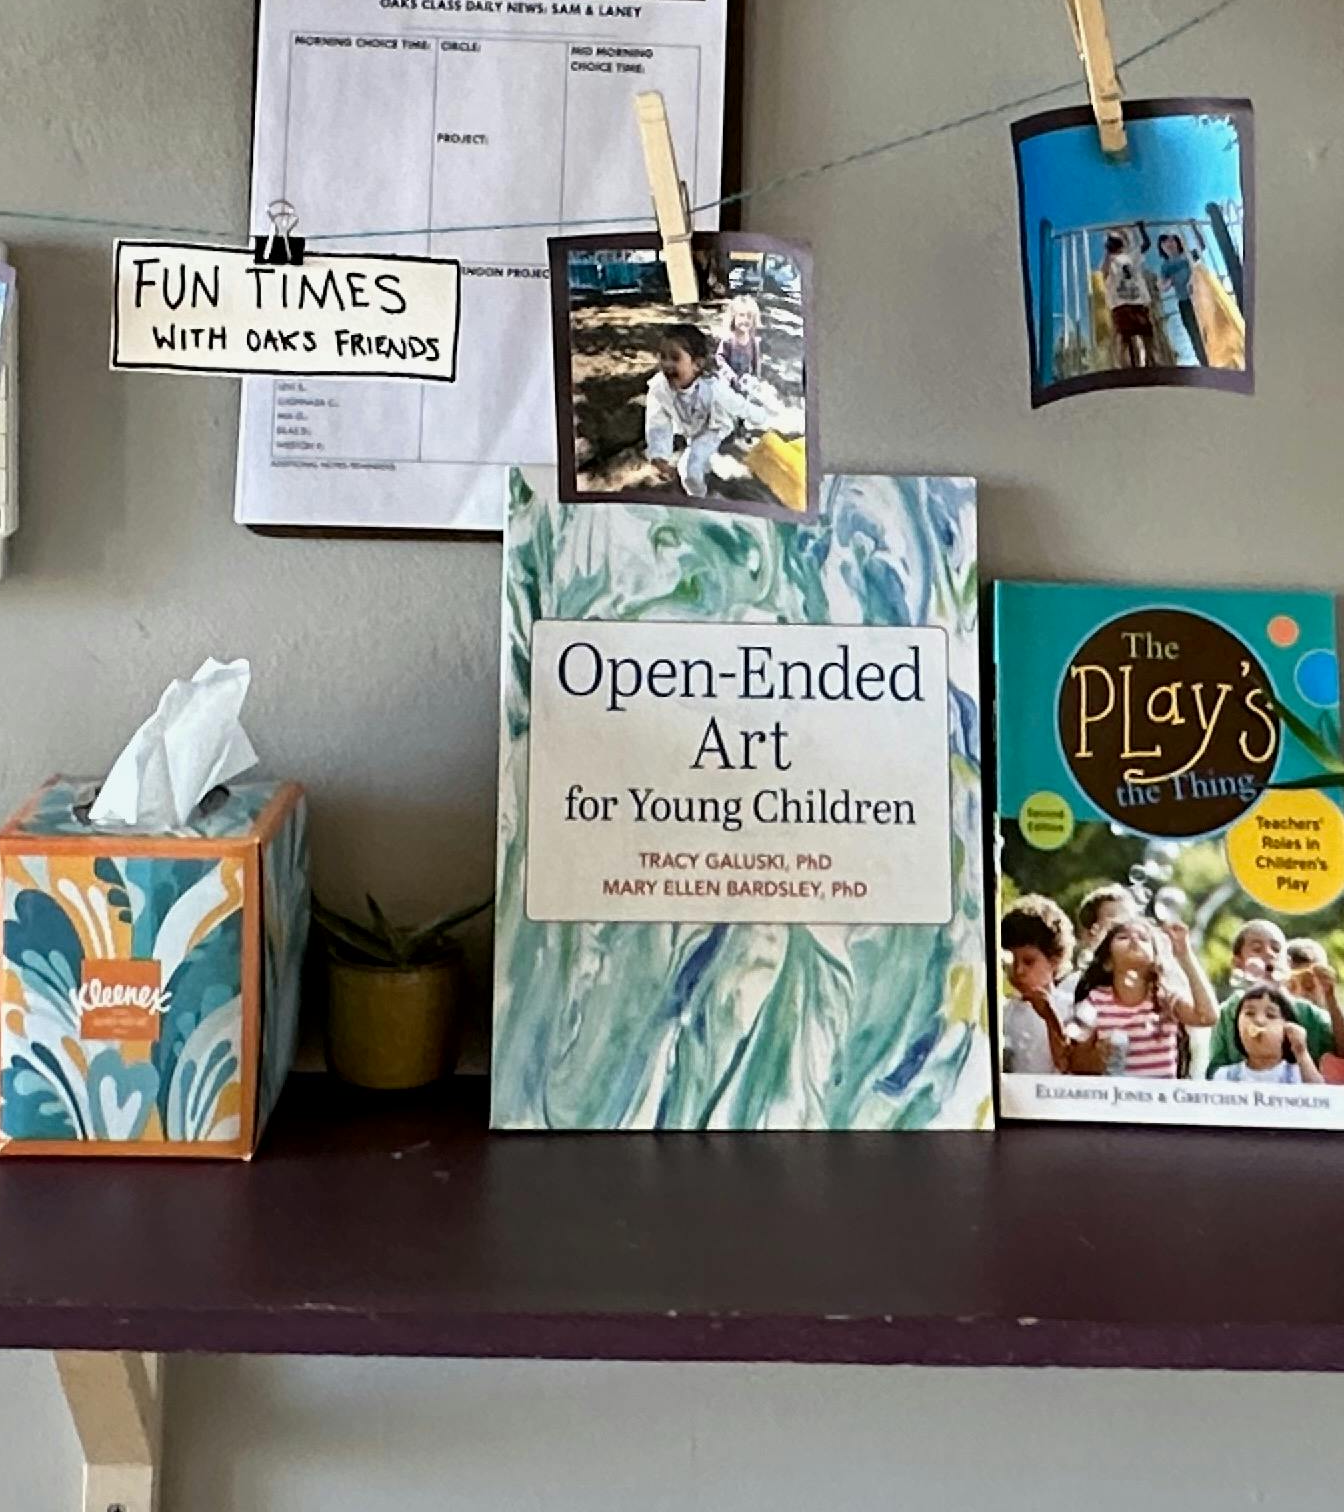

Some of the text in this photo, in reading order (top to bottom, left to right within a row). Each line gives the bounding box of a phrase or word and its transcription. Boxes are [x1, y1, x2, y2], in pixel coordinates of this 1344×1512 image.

[506, 0, 547, 15] NEWS:
[551, 2, 583, 16] SAM
[585, 3, 595, 17] &
[598, 4, 643, 19] LANEY
[294, 34, 654, 61] MORNING CHOICE TIME: CIRCLE: MID MORNING
[570, 60, 646, 75] CHOICE TIME:
[436, 131, 490, 146] PROJECT:
[506, 267, 550, 280] PROJEC
[132, 258, 408, 315] FUN TIMES
[152, 324, 441, 362] WITH OAKS FRIENDS
[1120, 630, 1180, 661] The
[556, 641, 926, 713] Open-Ended
[689, 715, 793, 772] Art
[1115, 769, 1259, 809] the Thing
[563, 785, 917, 832] for Young Children
[1025, 805, 1067, 822] Second
[1026, 821, 1067, 836] Edition
[1254, 814, 1325, 833] Teachers'
[1261, 834, 1321, 853] Roles in
[638, 852, 834, 874] TRACY GALUSKI, PhD
[1253, 854, 1330, 874] Children's
[601, 879, 869, 902] MARY ELLEN BARDSLEY, PhD
[1275, 874, 1310, 894] Play
[71, 978, 172, 1015] Kleenex
[1157, 1090, 1169, 1104] &
